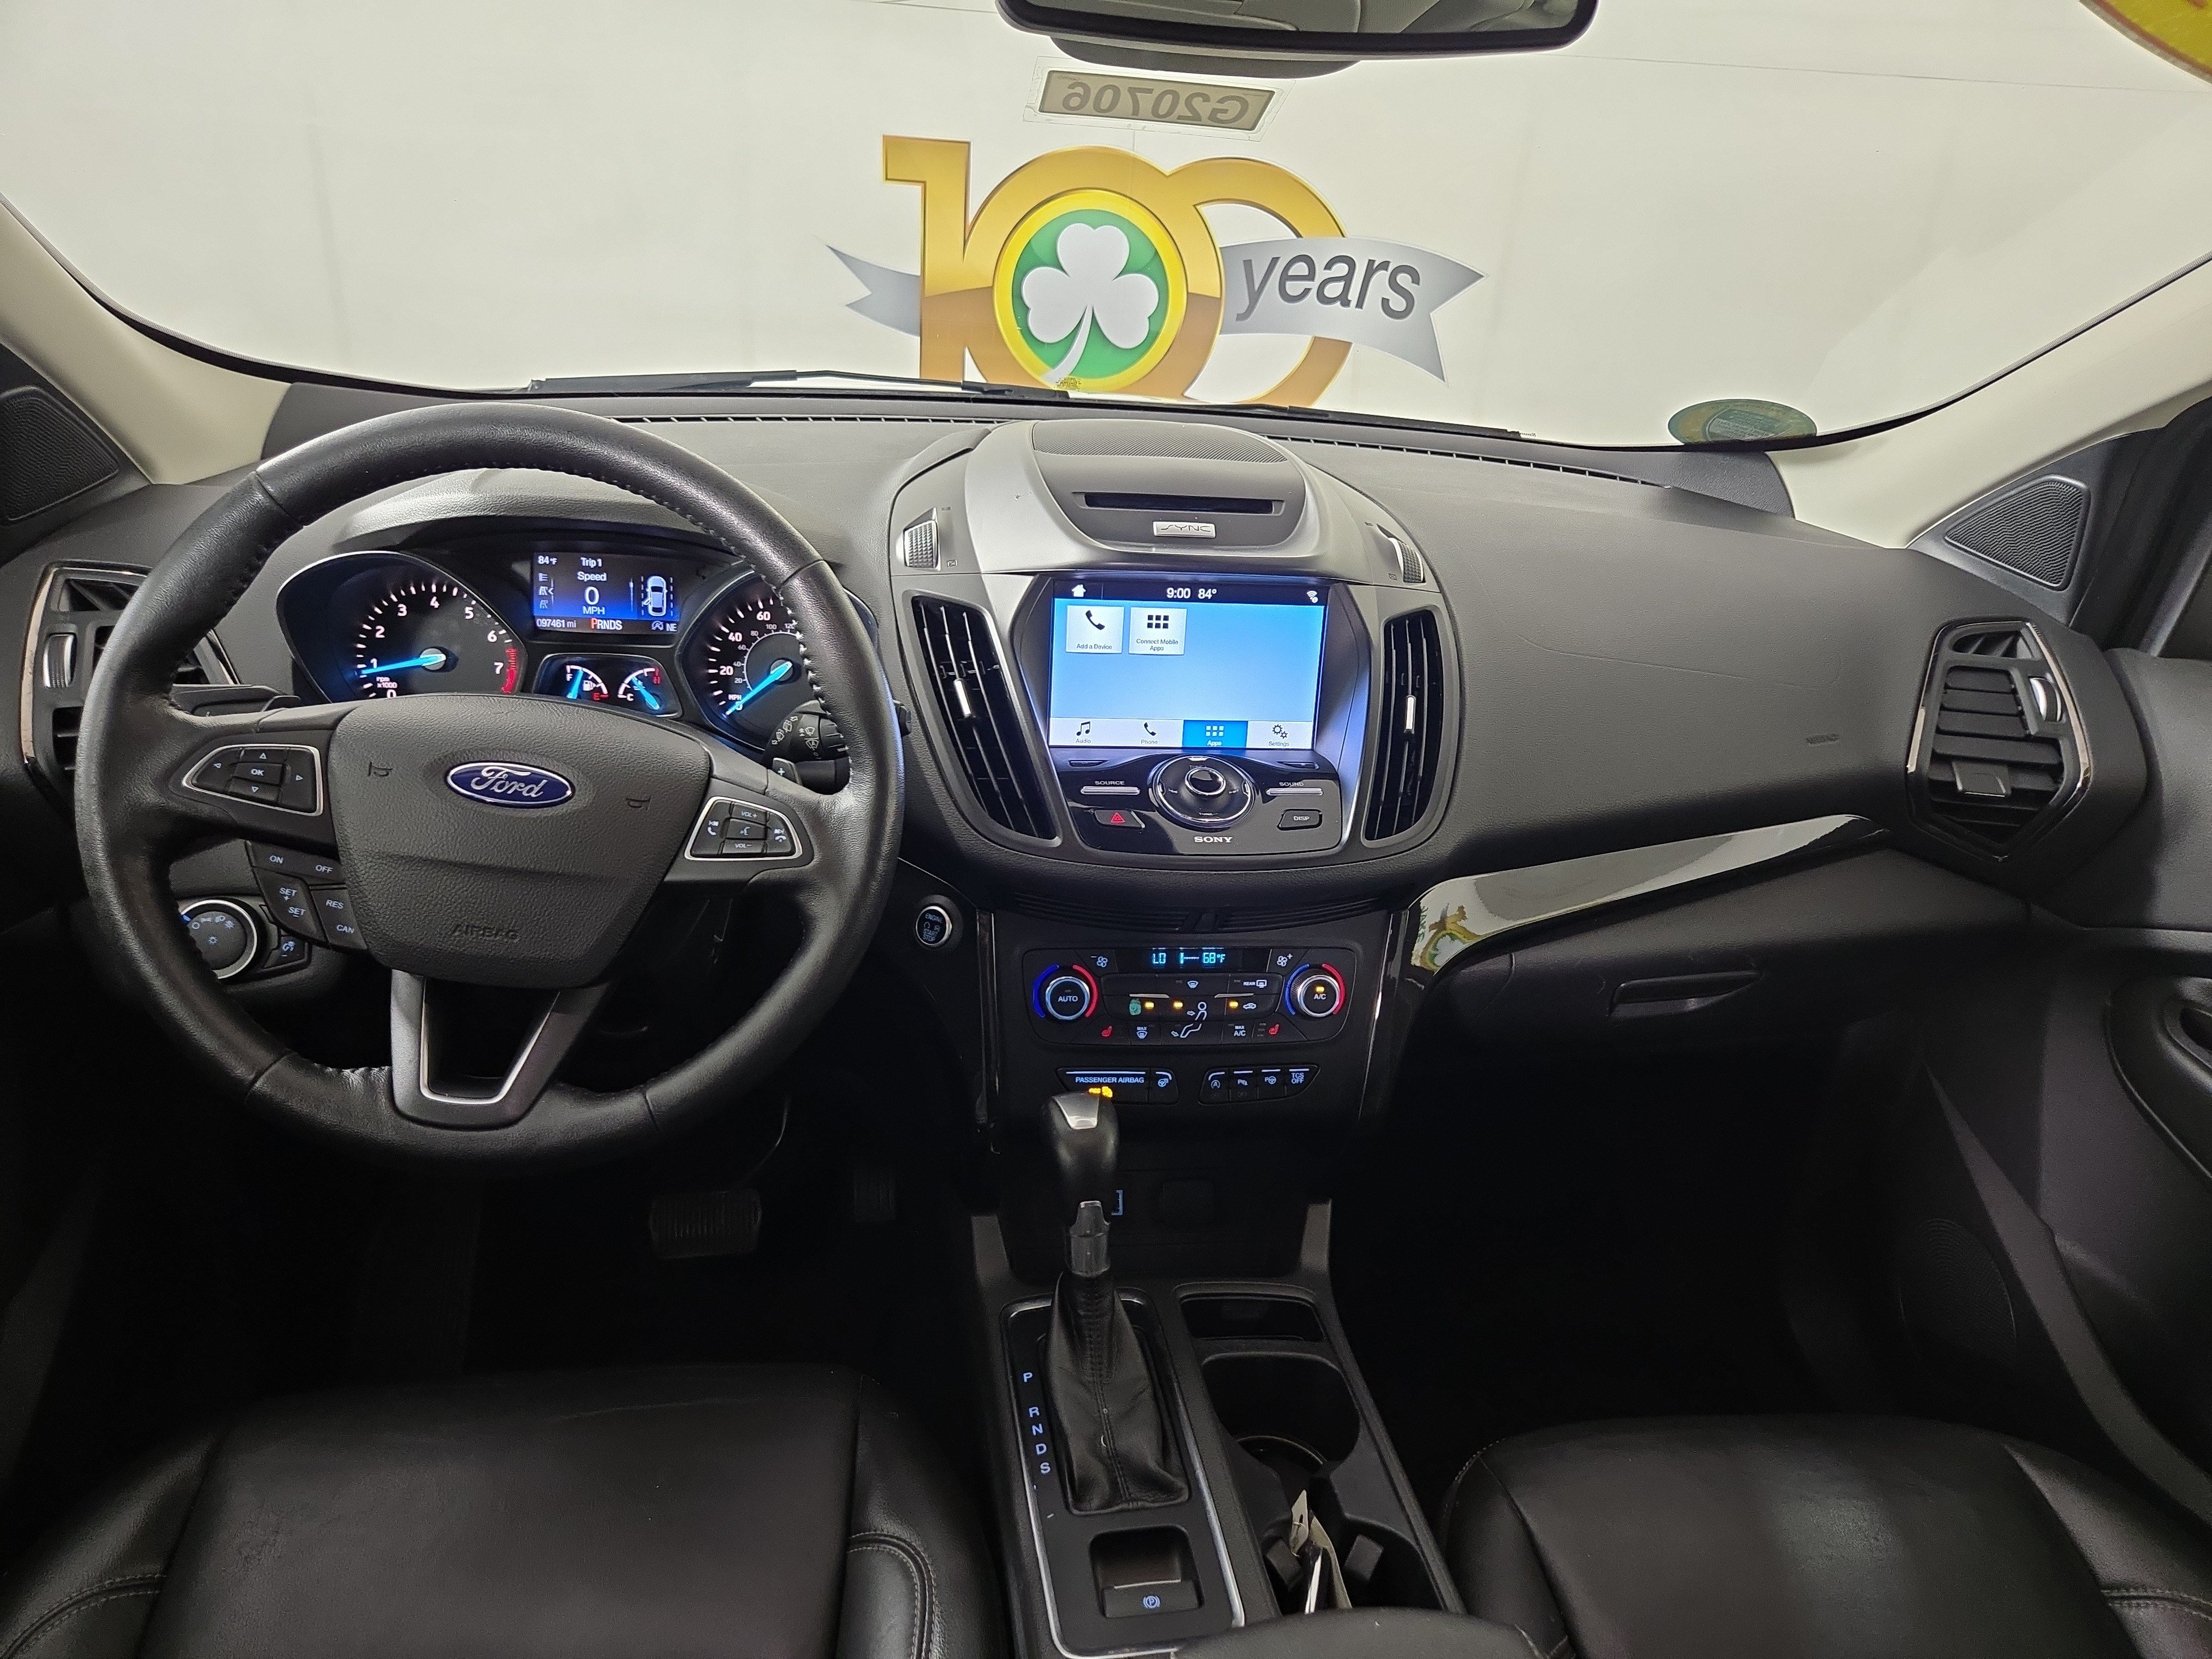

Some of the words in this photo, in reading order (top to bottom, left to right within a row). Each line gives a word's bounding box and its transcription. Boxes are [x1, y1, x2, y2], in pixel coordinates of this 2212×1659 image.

[1235, 253, 1420, 321] years
[1160, 524, 1211, 532] SYNC
[580, 557, 596, 568] Trip
[597, 558, 602, 567] 1
[577, 571, 607, 582] Speed
[584, 586, 600, 605] 0
[1166, 587, 1191, 599] 9:00
[429, 596, 439, 608] 4
[397, 603, 407, 616] 3
[465, 606, 474, 619] 5
[582, 606, 606, 615] MPH
[756, 610, 771, 621] 60
[536, 619, 565, 628] 097461
[567, 620, 577, 628] mi
[666, 623, 678, 632] NE
[375, 625, 385, 638] 2
[487, 630, 498, 642] 6
[728, 632, 743, 642] 40
[370, 658, 378, 668] 1
[493, 661, 504, 674] 7
[719, 665, 734, 676] 20
[565, 673, 573, 681] F
[386, 689, 397, 698] 0
[626, 693, 634, 702] C
[1206, 739, 1223, 747] Apps
[1268, 740, 1290, 748] Settings
[250, 768, 265, 777] OK
[471, 766, 549, 798] Ford
[1194, 835, 1233, 844] SONY
[269, 855, 284, 864] ON
[315, 864, 333, 874] OFF
[279, 886, 298, 897] SET
[325, 899, 344, 910] RES
[288, 905, 306, 916] SET
[336, 924, 355, 934] CAN
[1023, 1372, 1033, 1382] P
[1028, 1406, 1040, 1418] R
[1032, 1423, 1043, 1436] N
[1036, 1443, 1047, 1455] D
[1040, 1462, 1051, 1474] S
